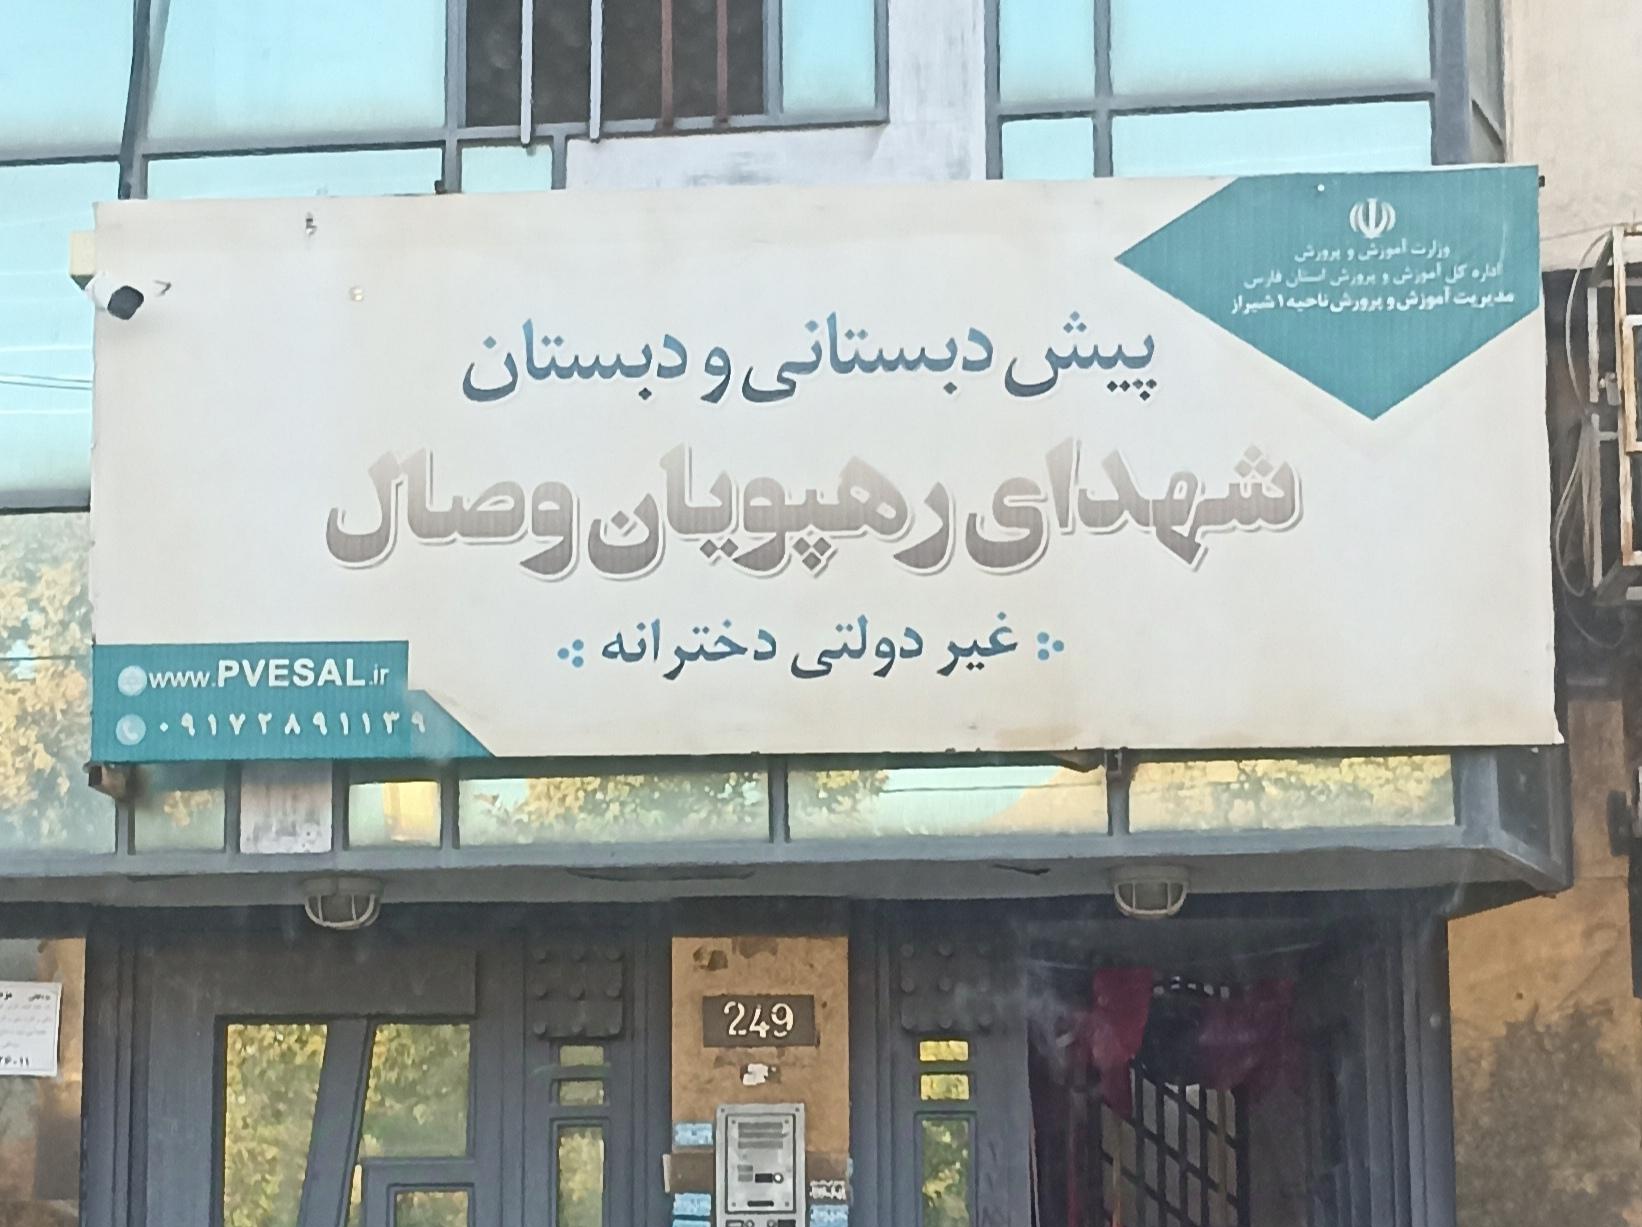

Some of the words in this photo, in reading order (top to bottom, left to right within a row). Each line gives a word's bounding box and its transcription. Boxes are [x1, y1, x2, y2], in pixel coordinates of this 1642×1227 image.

[1294, 244, 1341, 262] پرورش
[1347, 248, 1355, 261] و
[1358, 238, 1407, 261] آموزش
[1411, 239, 1450, 259] وزارت
[1243, 269, 1283, 289] فارس
[1285, 268, 1326, 289] استان
[1329, 268, 1377, 287] پرورش
[1382, 272, 1389, 286] و
[1393, 262, 1442, 285] آموزش
[1445, 263, 1468, 284] کل
[1471, 262, 1503, 283] اداره
[1231, 294, 1275, 315] شیراز
[1286, 292, 1329, 313] ناحیه
[1330, 292, 1383, 313] پرورش
[1386, 296, 1395, 311] و
[1396, 286, 1451, 312] آموزش
[1453, 290, 1515, 309] مدیریت
[461, 318, 688, 404] دبستان
[741, 311, 995, 404] دبستانی
[1004, 310, 1158, 401] پیش
[700, 338, 732, 404] و
[326, 446, 576, 578] وصال
[587, 442, 952, 578] رهپویان
[965, 437, 1300, 572] شهدای
[600, 616, 777, 681] دخترانه
[790, 614, 923, 679] دولتی
[936, 611, 1018, 675] غیر
[148, 657, 390, 690] www.PVESAL.ir
[724, 1001, 794, 1038] 249
